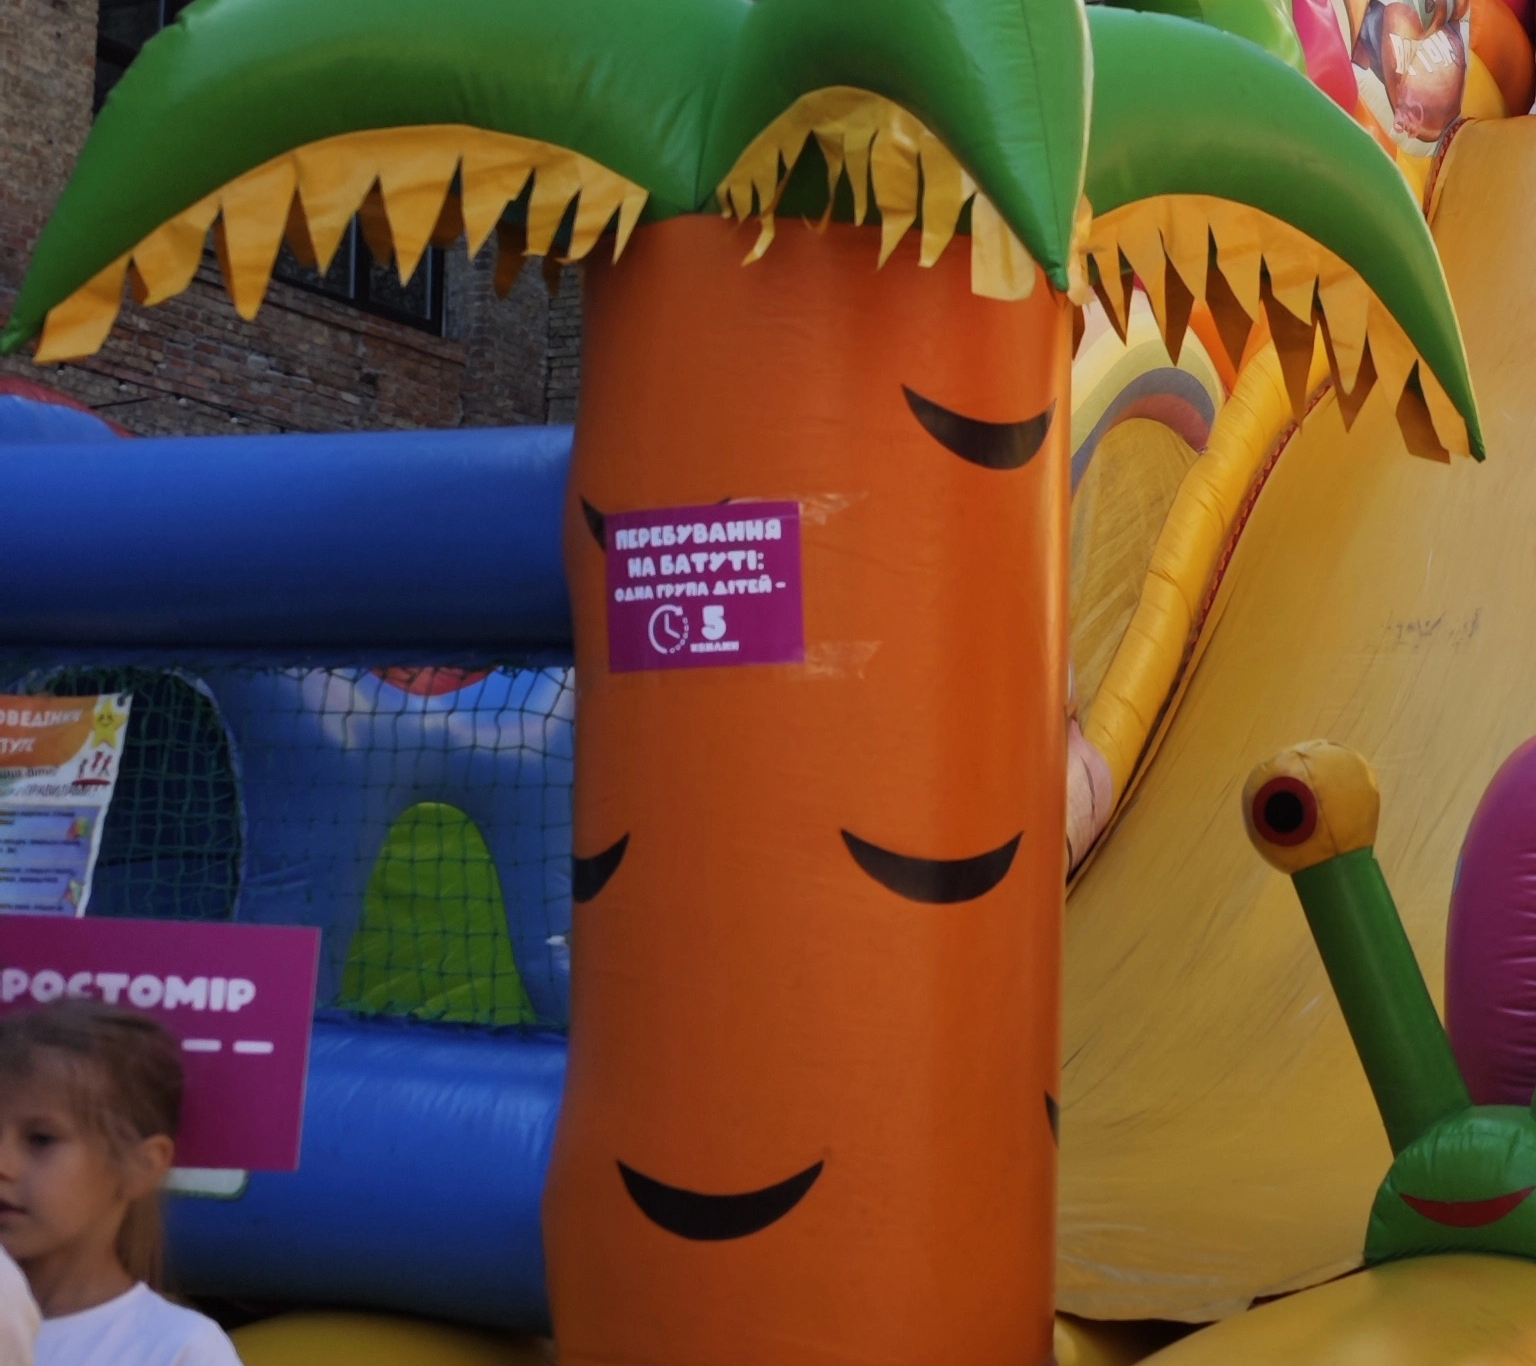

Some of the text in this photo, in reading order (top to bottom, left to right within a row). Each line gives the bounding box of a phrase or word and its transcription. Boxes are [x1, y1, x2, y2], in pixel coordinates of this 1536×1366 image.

[615, 518, 782, 550] ПЕРЕБУВАННЯ
[627, 549, 765, 578] НА БАТУТІ:
[614, 586, 654, 602] ОДНА
[656, 581, 709, 598] ГРУПА
[712, 574, 772, 596] ДІТЕЙ
[701, 605, 727, 641] 5
